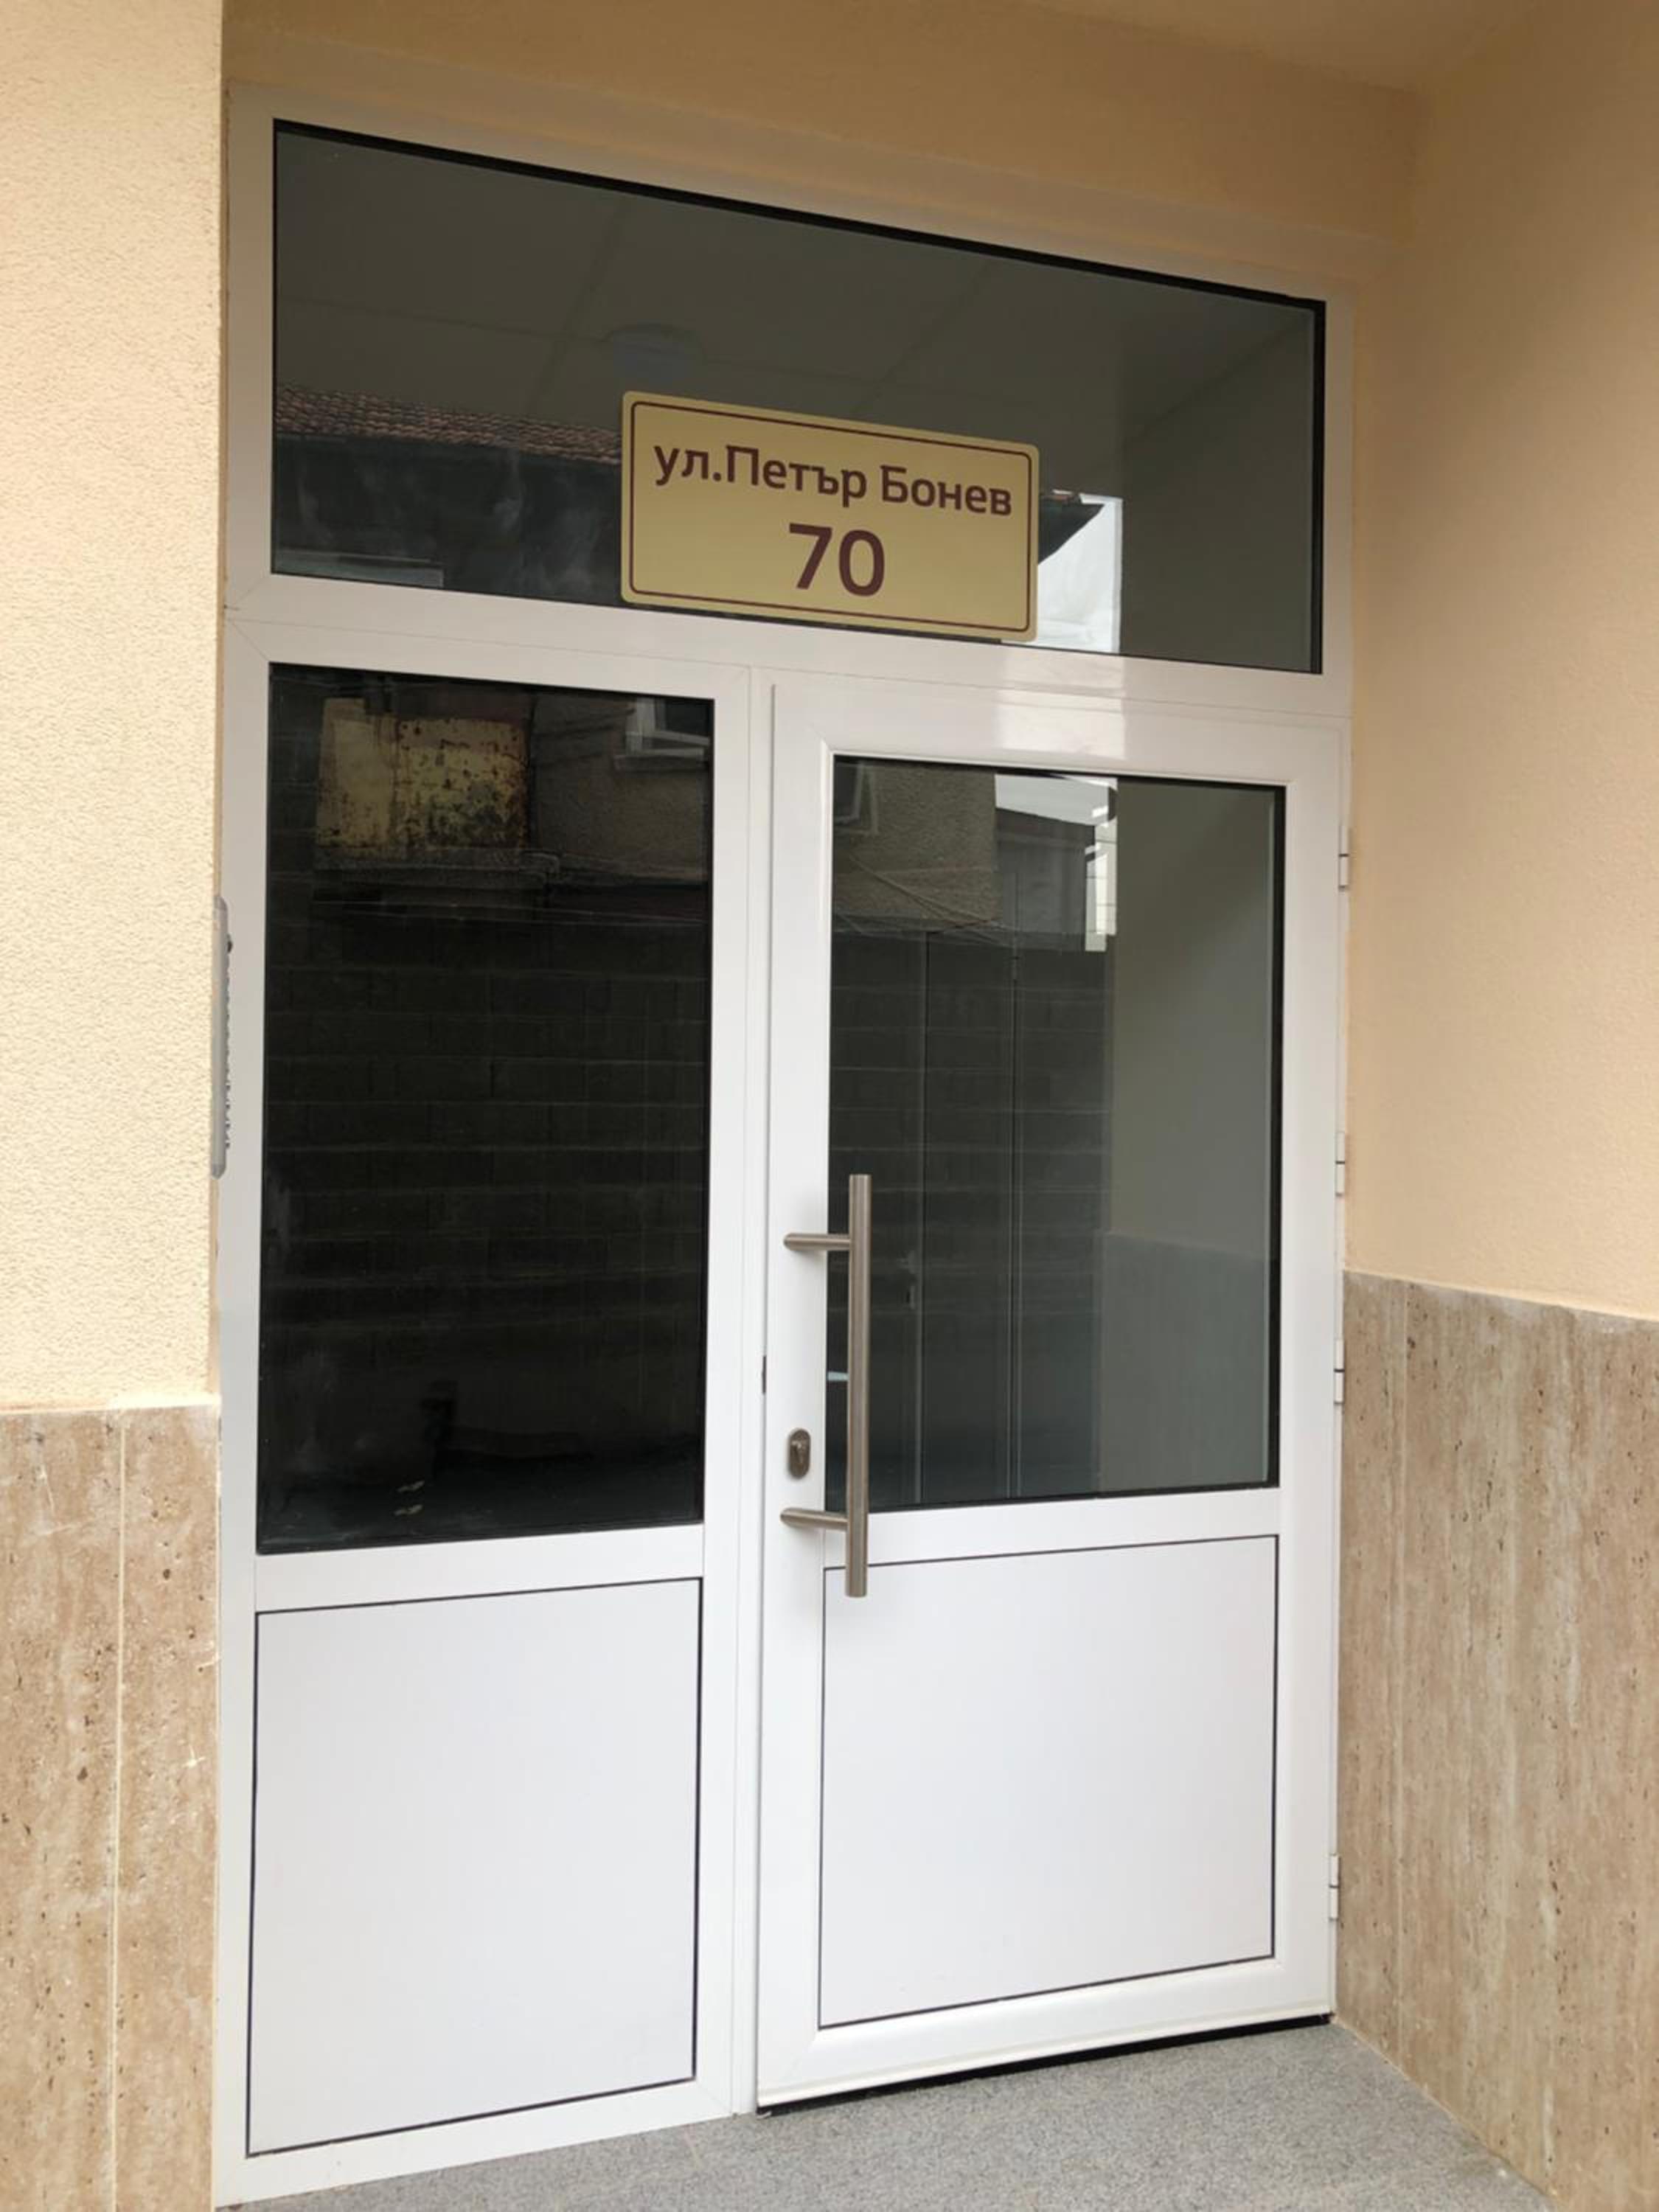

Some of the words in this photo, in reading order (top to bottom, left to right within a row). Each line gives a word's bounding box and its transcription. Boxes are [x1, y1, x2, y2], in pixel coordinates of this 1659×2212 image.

[653, 444, 867, 508] ул.Петър
[879, 464, 1012, 516] Бонев
[789, 522, 886, 597] 70
